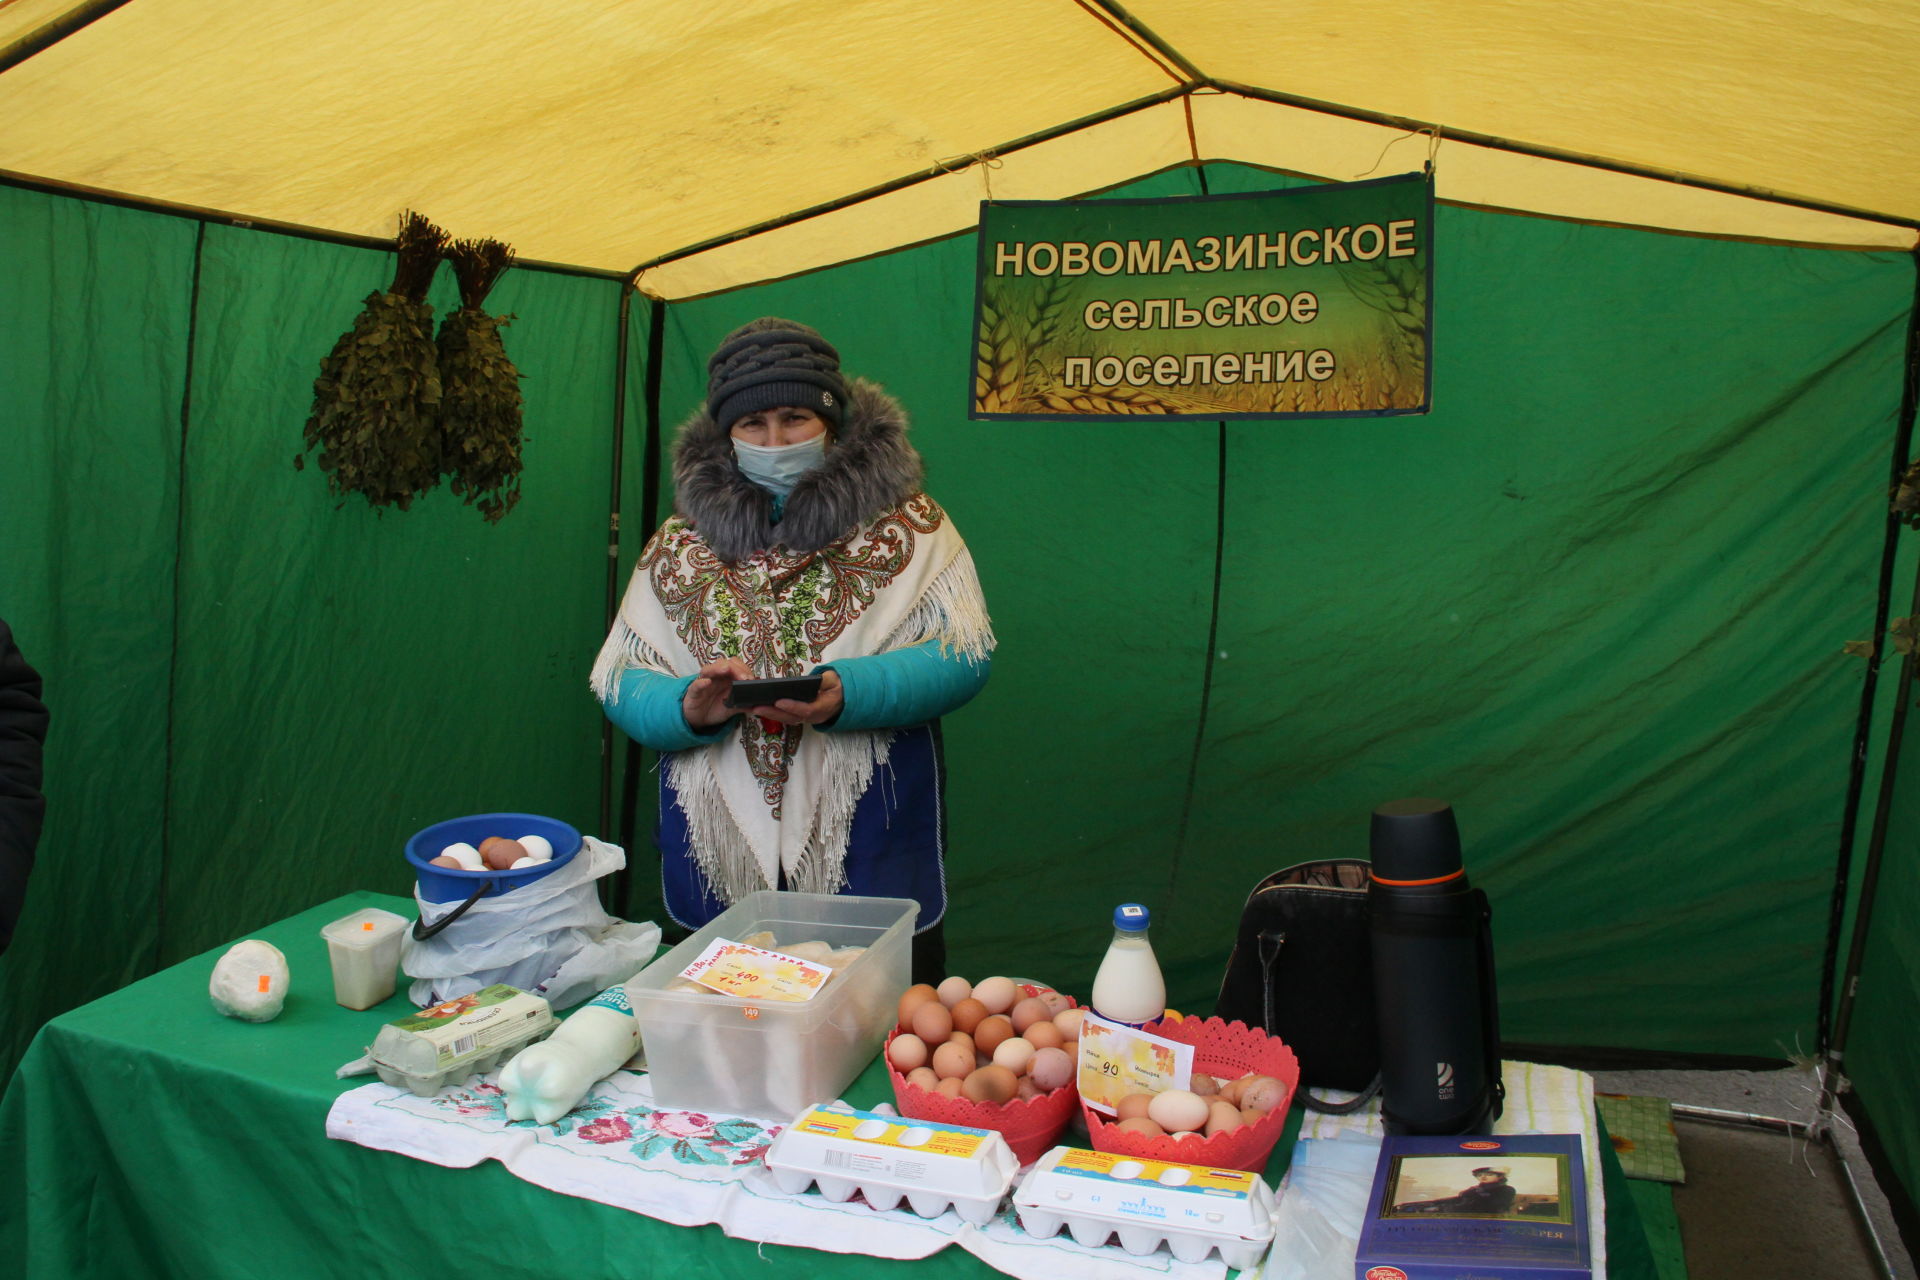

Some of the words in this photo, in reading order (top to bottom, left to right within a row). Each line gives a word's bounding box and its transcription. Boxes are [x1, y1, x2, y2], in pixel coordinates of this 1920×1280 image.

[994, 219, 1417, 278] НОВОМАЗИНСКОЕ
[1083, 290, 1319, 331] сельское
[1064, 348, 1336, 387] поселение
[736, 971, 759, 982] 400
[1103, 1061, 1119, 1076] 90
